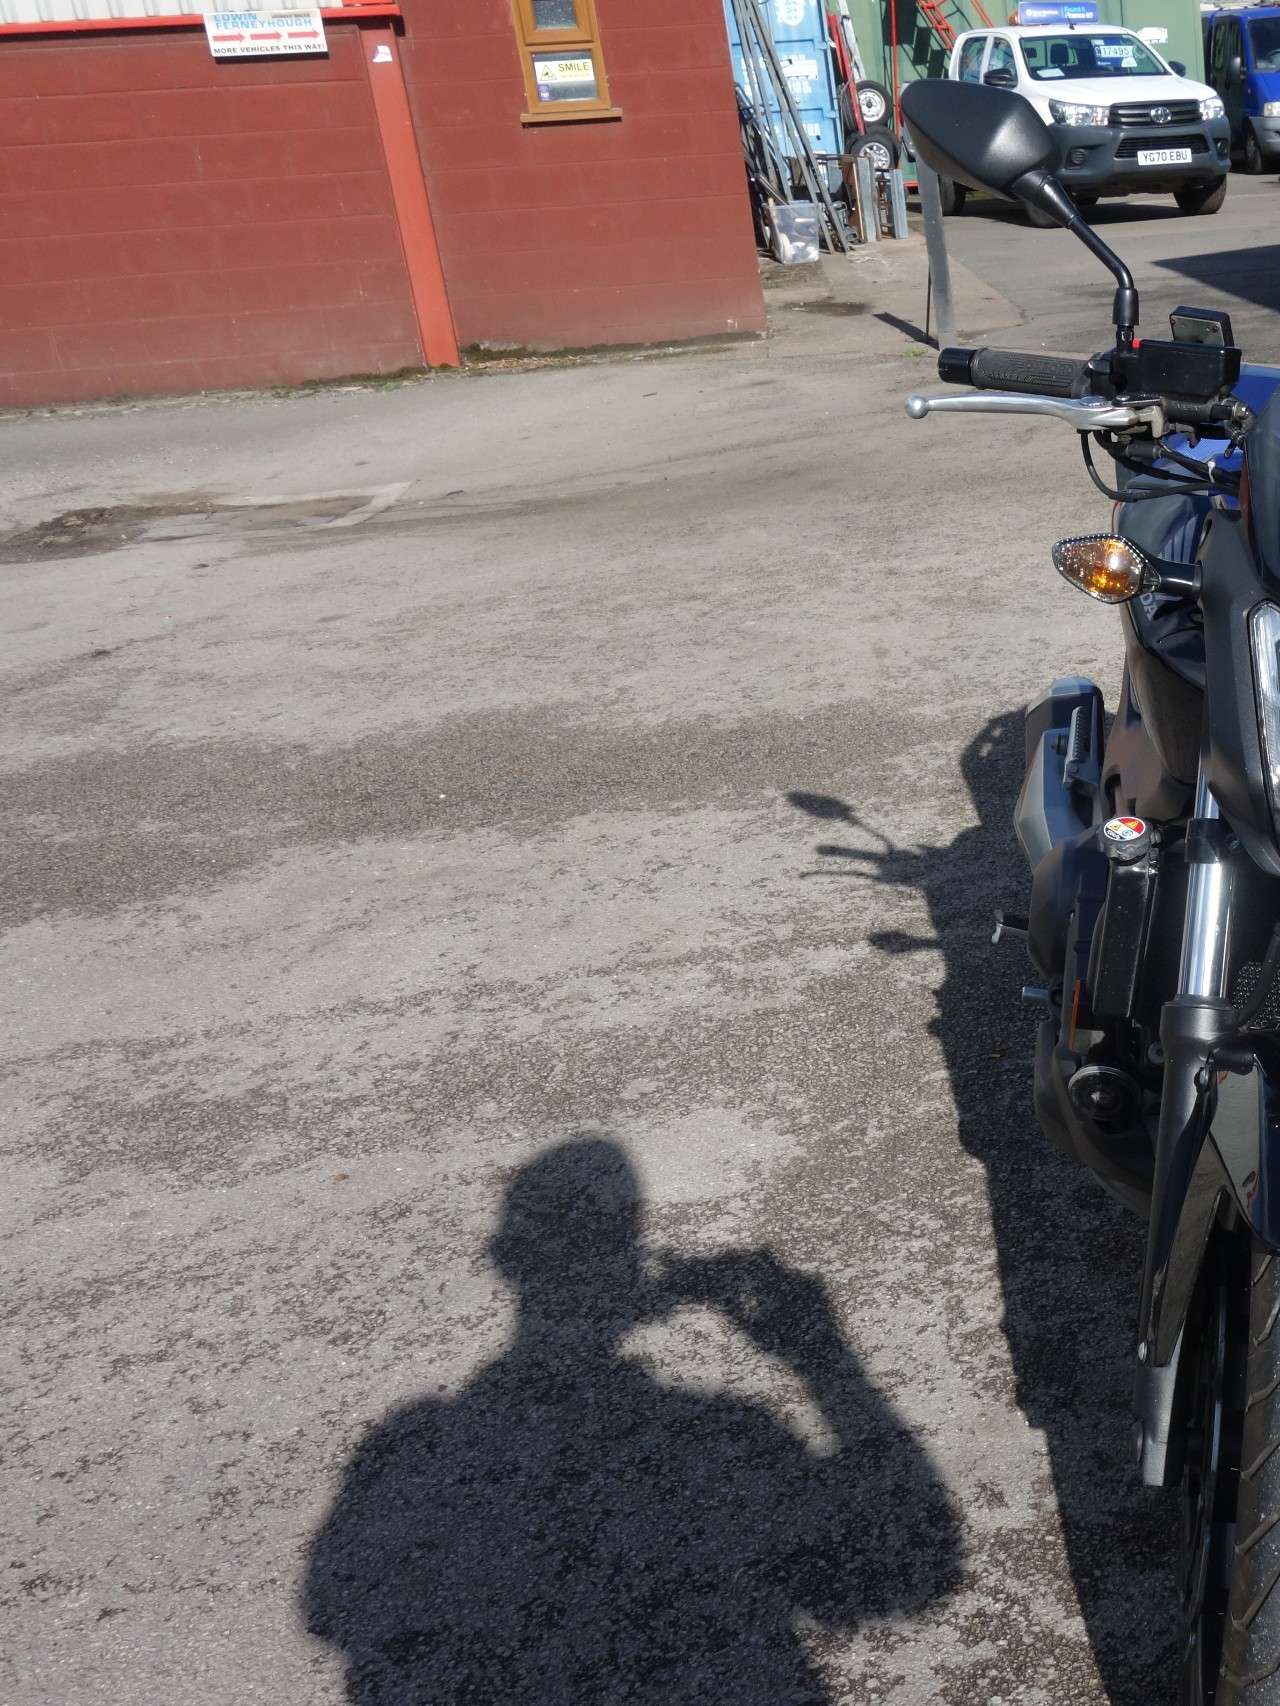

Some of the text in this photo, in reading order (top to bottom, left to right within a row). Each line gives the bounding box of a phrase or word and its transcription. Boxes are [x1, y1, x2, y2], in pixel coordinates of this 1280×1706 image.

[214, 13, 256, 22] EDWIN
[215, 18, 312, 30] FERNEYHOUGH
[240, 45, 280, 53] VEHICLES
[558, 62, 589, 72] SMILE
[1143, 150, 1187, 162] YG70 EBU
